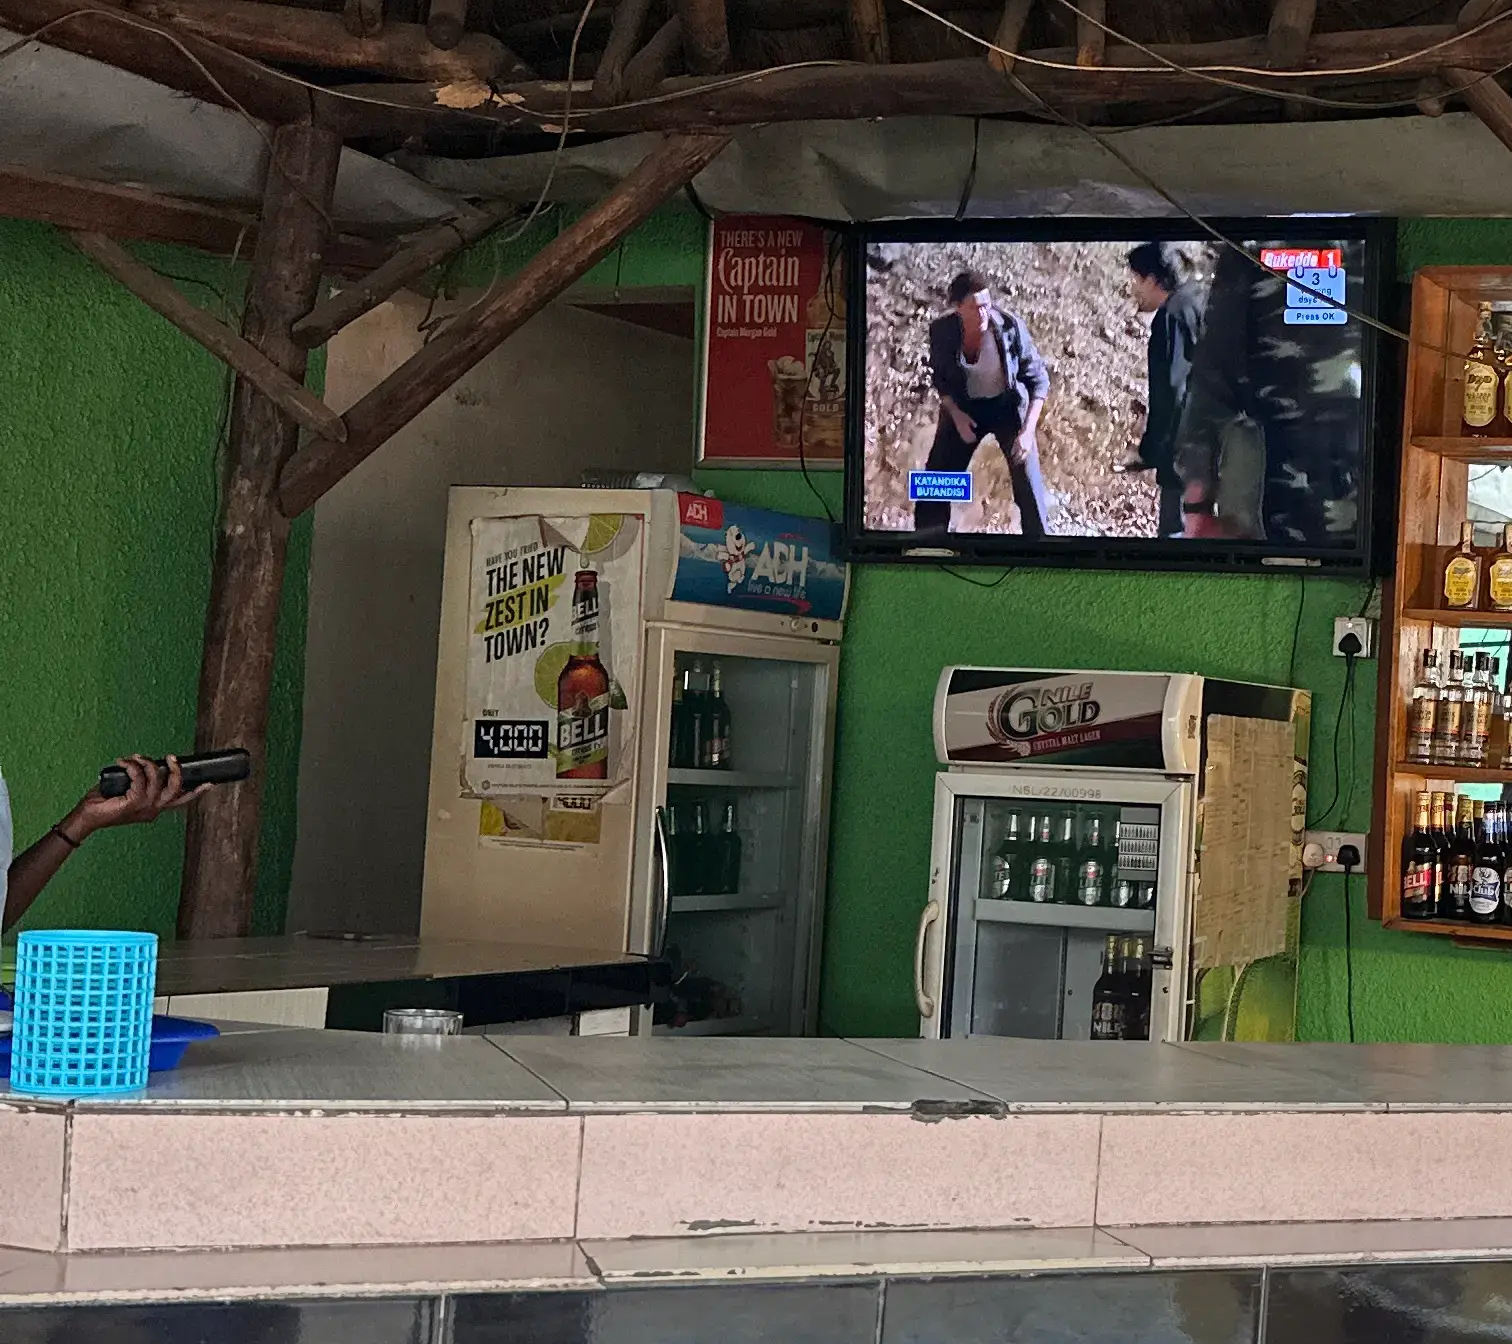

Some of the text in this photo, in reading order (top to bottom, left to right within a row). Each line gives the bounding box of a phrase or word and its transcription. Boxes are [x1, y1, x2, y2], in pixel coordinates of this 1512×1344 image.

[720, 230, 804, 248] THERE'S A NEW
[718, 247, 800, 294] Captain
[1327, 252, 1334, 267] 1
[1312, 272, 1320, 285] 3
[718, 294, 799, 323] IN TOWN
[1322, 312, 1335, 321] OK
[914, 476, 968, 487] KATANDIKA
[916, 487, 965, 497] BUTANDISI
[504, 548, 518, 560] YOU
[486, 546, 565, 597] THE NEW
[747, 579, 763, 594] live
[764, 586, 771, 595] a
[772, 587, 791, 599] new
[484, 584, 550, 632] ZEST IN
[484, 617, 550, 663] TOWN?
[1041, 681, 1094, 707] NILE
[1000, 686, 1101, 740] GOLD
[480, 724, 543, 755] 4,000
[560, 713, 604, 747] BELL
[1449, 882, 1469, 895] NIL
